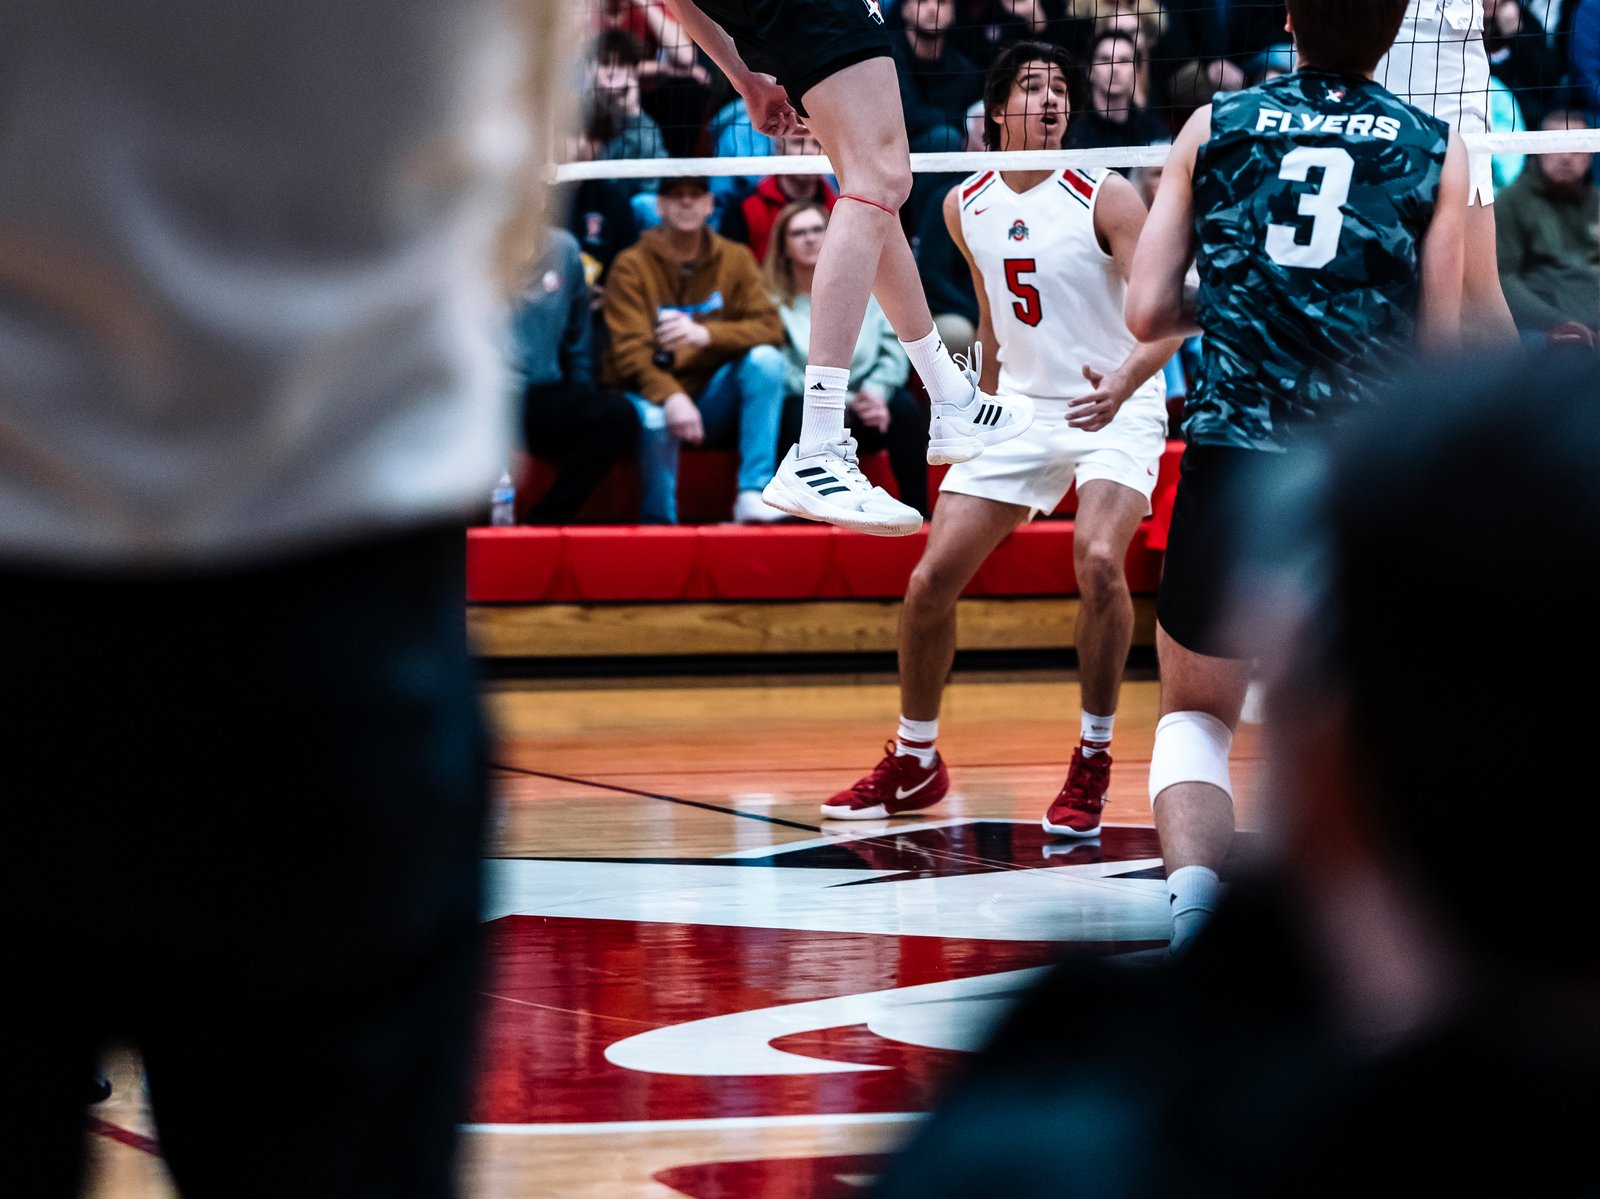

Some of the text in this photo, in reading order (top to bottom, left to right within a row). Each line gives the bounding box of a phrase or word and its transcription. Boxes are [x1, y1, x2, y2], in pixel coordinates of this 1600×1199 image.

[1255, 108, 1401, 141] FLYERS
[1264, 145, 1355, 269] 3
[1004, 258, 1043, 327] 5
